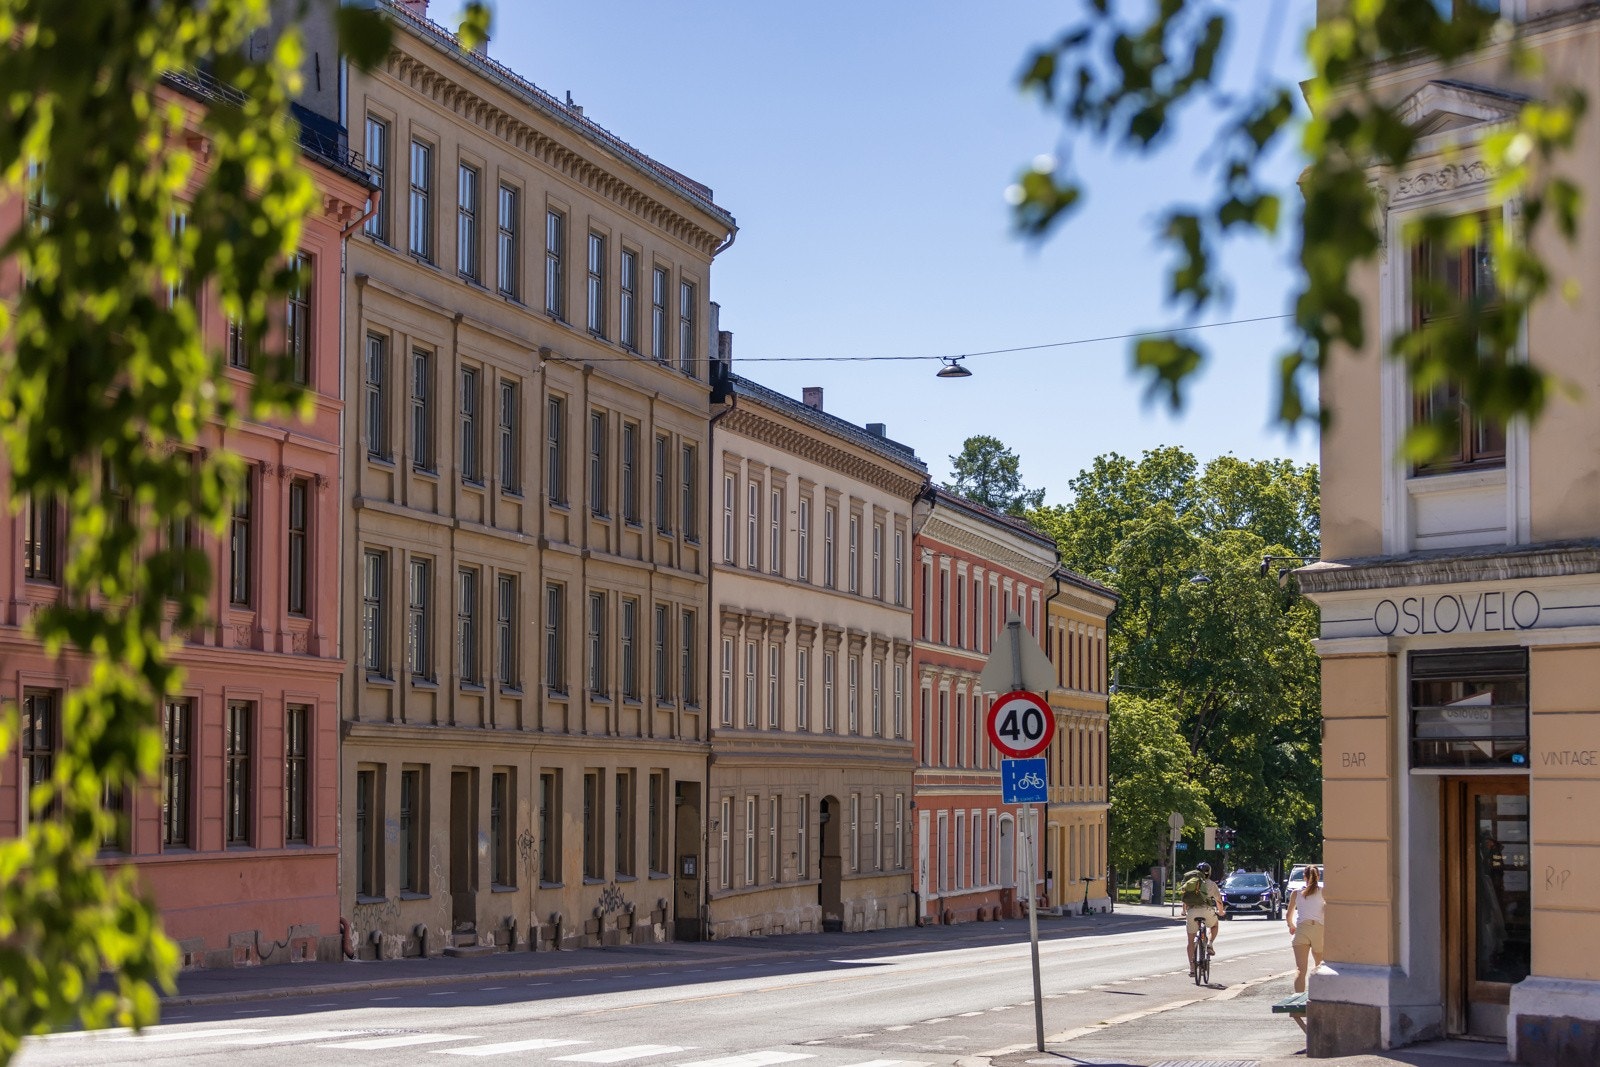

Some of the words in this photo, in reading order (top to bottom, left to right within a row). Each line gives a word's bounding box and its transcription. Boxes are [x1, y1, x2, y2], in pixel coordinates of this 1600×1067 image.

[1374, 590, 1540, 635] OSLOVELO
[999, 708, 1044, 741] 40
[1342, 752, 1366, 767] BAR
[1540, 750, 1598, 766] VINTAGE
